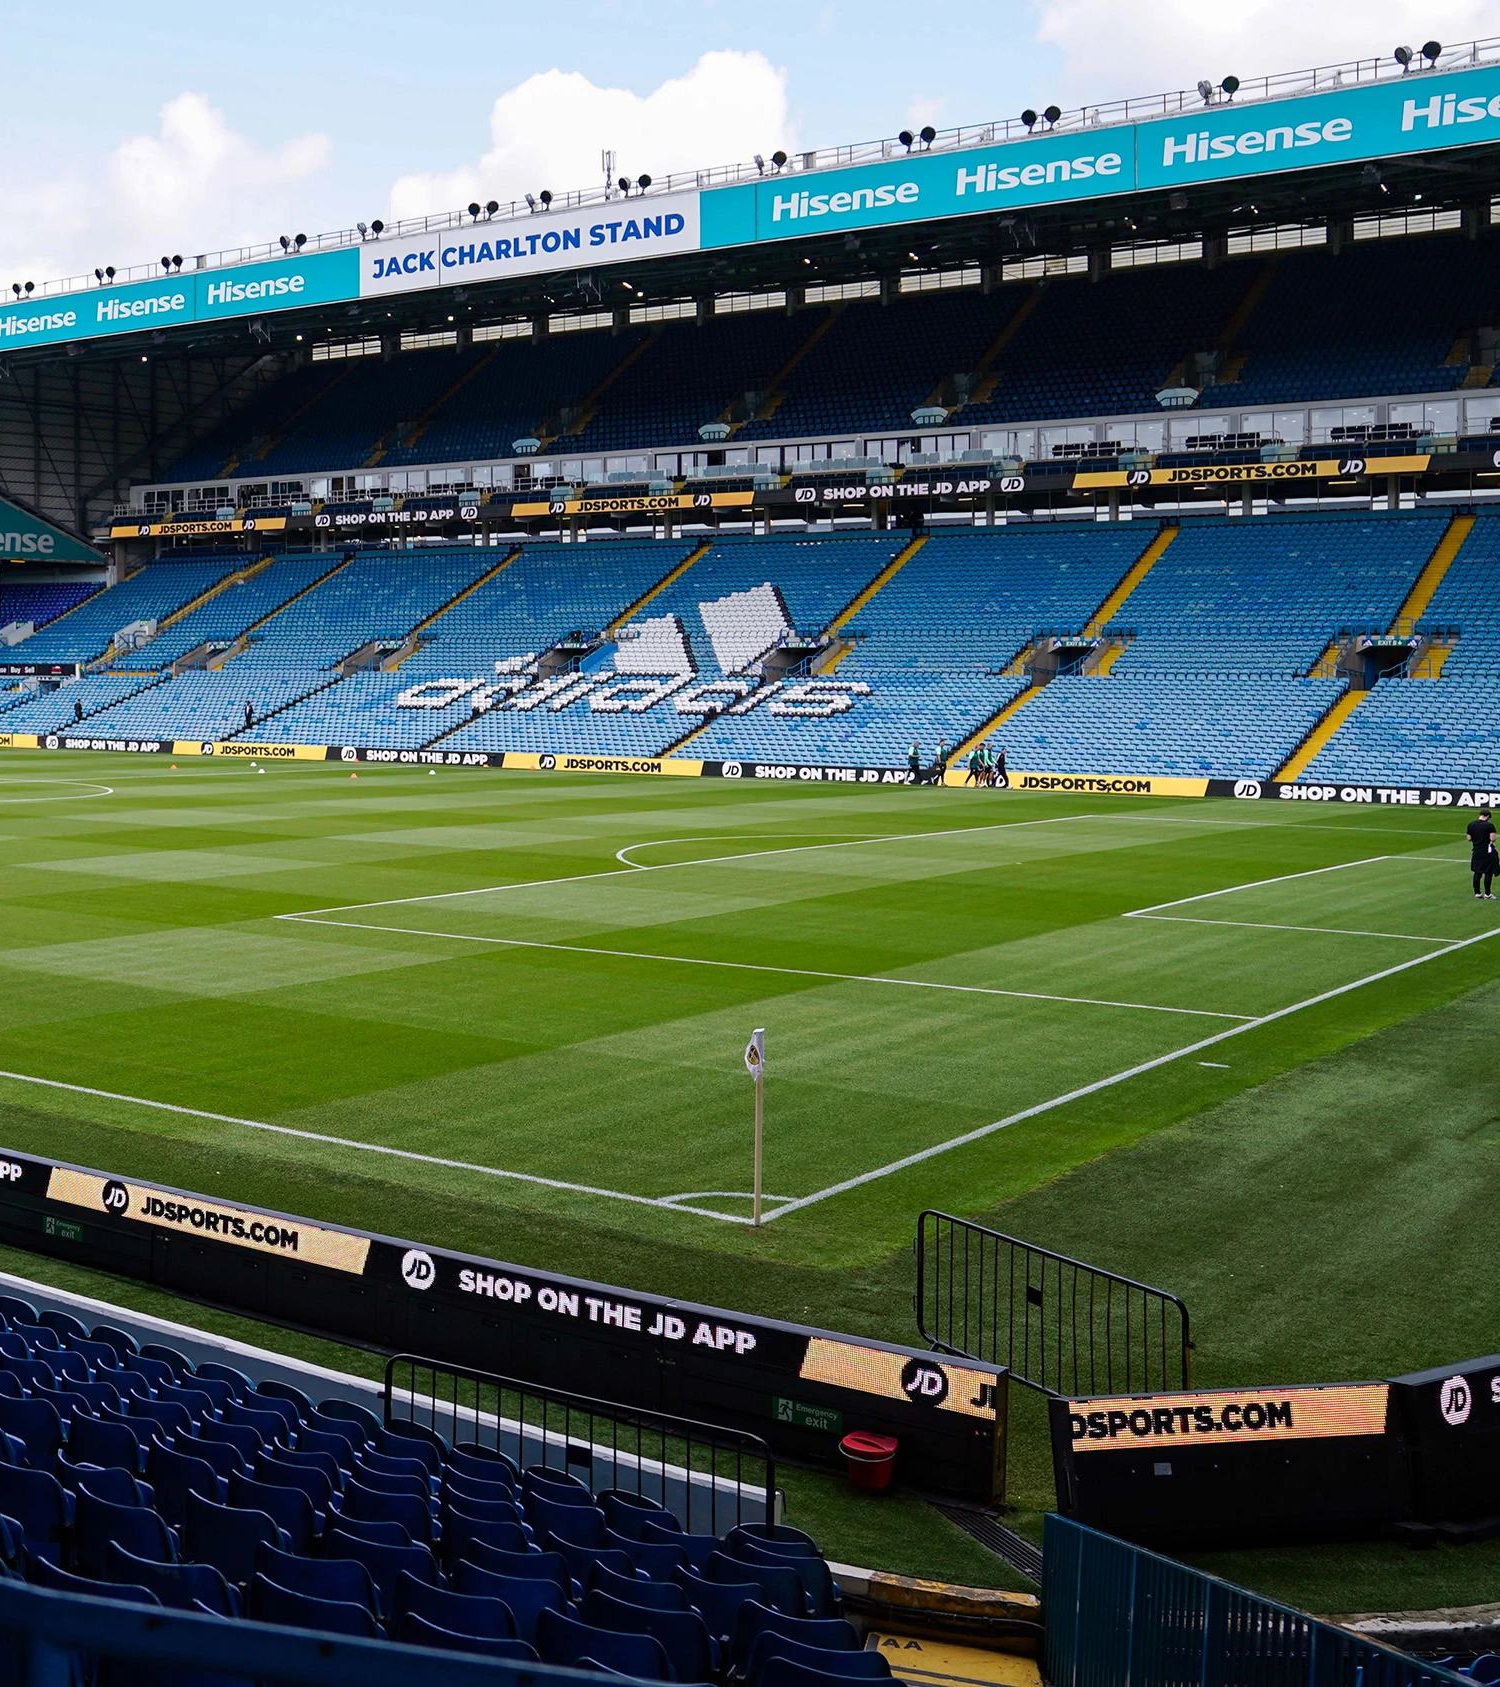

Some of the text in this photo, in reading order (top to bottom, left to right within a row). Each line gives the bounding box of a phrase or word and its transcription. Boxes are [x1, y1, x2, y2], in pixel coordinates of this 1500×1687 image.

[1163, 118, 1353, 166] Hisense
[956, 153, 1122, 196] Hisense
[772, 182, 920, 221] Hisense
[372, 213, 685, 279] JACK CHARLTON STAND
[207, 274, 305, 305] Hisense
[97, 293, 185, 321] Hisense
[1167, 463, 1317, 483] JDSPORTS.COM
[823, 487, 867, 501] SHOP
[870, 485, 892, 499] ON
[897, 483, 929, 496] THE
[932, 482, 953, 495] JD
[956, 479, 991, 493] APP
[577, 496, 680, 511] JDSPORTS.COM
[335, 508, 454, 525] SHOP ON THE JD APP
[158, 522, 233, 535] JDSPORTS.COM
[65, 739, 160, 752] SHOP ON THE JD APP
[220, 745, 296, 757] JDSPORTS.COM
[366, 750, 398, 761] SHOP
[400, 751, 417, 762] ON
[418, 752, 443, 764] THE
[445, 753, 460, 765] JD
[462, 754, 488, 766] APP
[563, 758, 662, 773] JDSPORTS.COM
[755, 765, 797, 778] SHOP
[799, 766, 821, 779] ON
[825, 767, 856, 781] THE
[859, 769, 878, 782] JD
[1020, 777, 1152, 792] JDSPORTS.COM
[1279, 785, 1337, 801] SHOP
[1340, 787, 1373, 803] ON
[1377, 789, 1420, 804] THE
[1425, 791, 1452, 806] JD
[141, 1196, 299, 1251] JDSPORTS.COM
[459, 1269, 531, 1304] SHOP
[538, 1287, 579, 1317] ON
[585, 1297, 642, 1331] THE
[648, 1313, 686, 1341] JD
[692, 1323, 757, 1355] APP
[796, 1403, 838, 1420] Emergency
[805, 1416, 828, 1430] exit
[881, 1637, 924, 1652] AA
